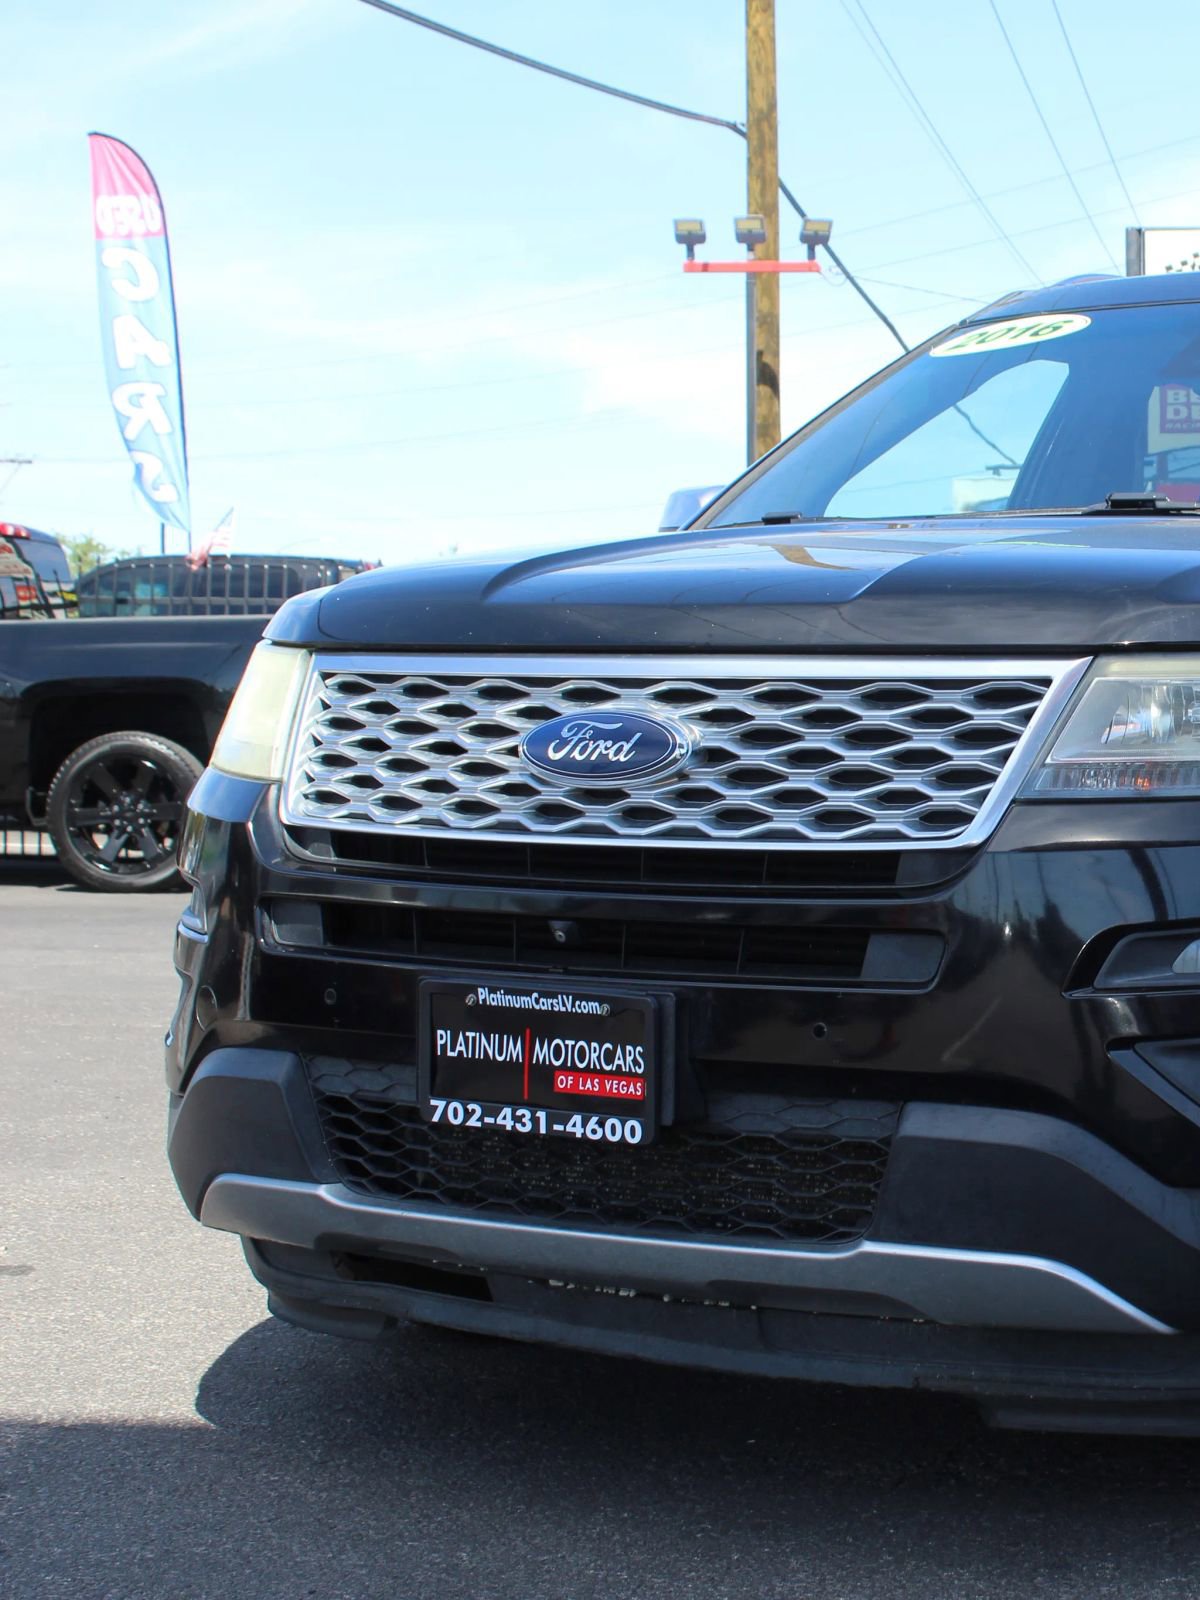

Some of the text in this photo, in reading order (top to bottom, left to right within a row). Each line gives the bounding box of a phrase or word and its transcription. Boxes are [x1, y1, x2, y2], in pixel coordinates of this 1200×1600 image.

[946, 319, 1074, 351] 2016
[547, 720, 643, 762] Ford
[477, 987, 602, 1016] PlatinumCarsLV.com
[436, 1029, 645, 1074] PLATINUM MOTORCARS
[557, 1076, 642, 1096] OF LAS VEGAS
[430, 1099, 643, 1145] 702-431-4600
